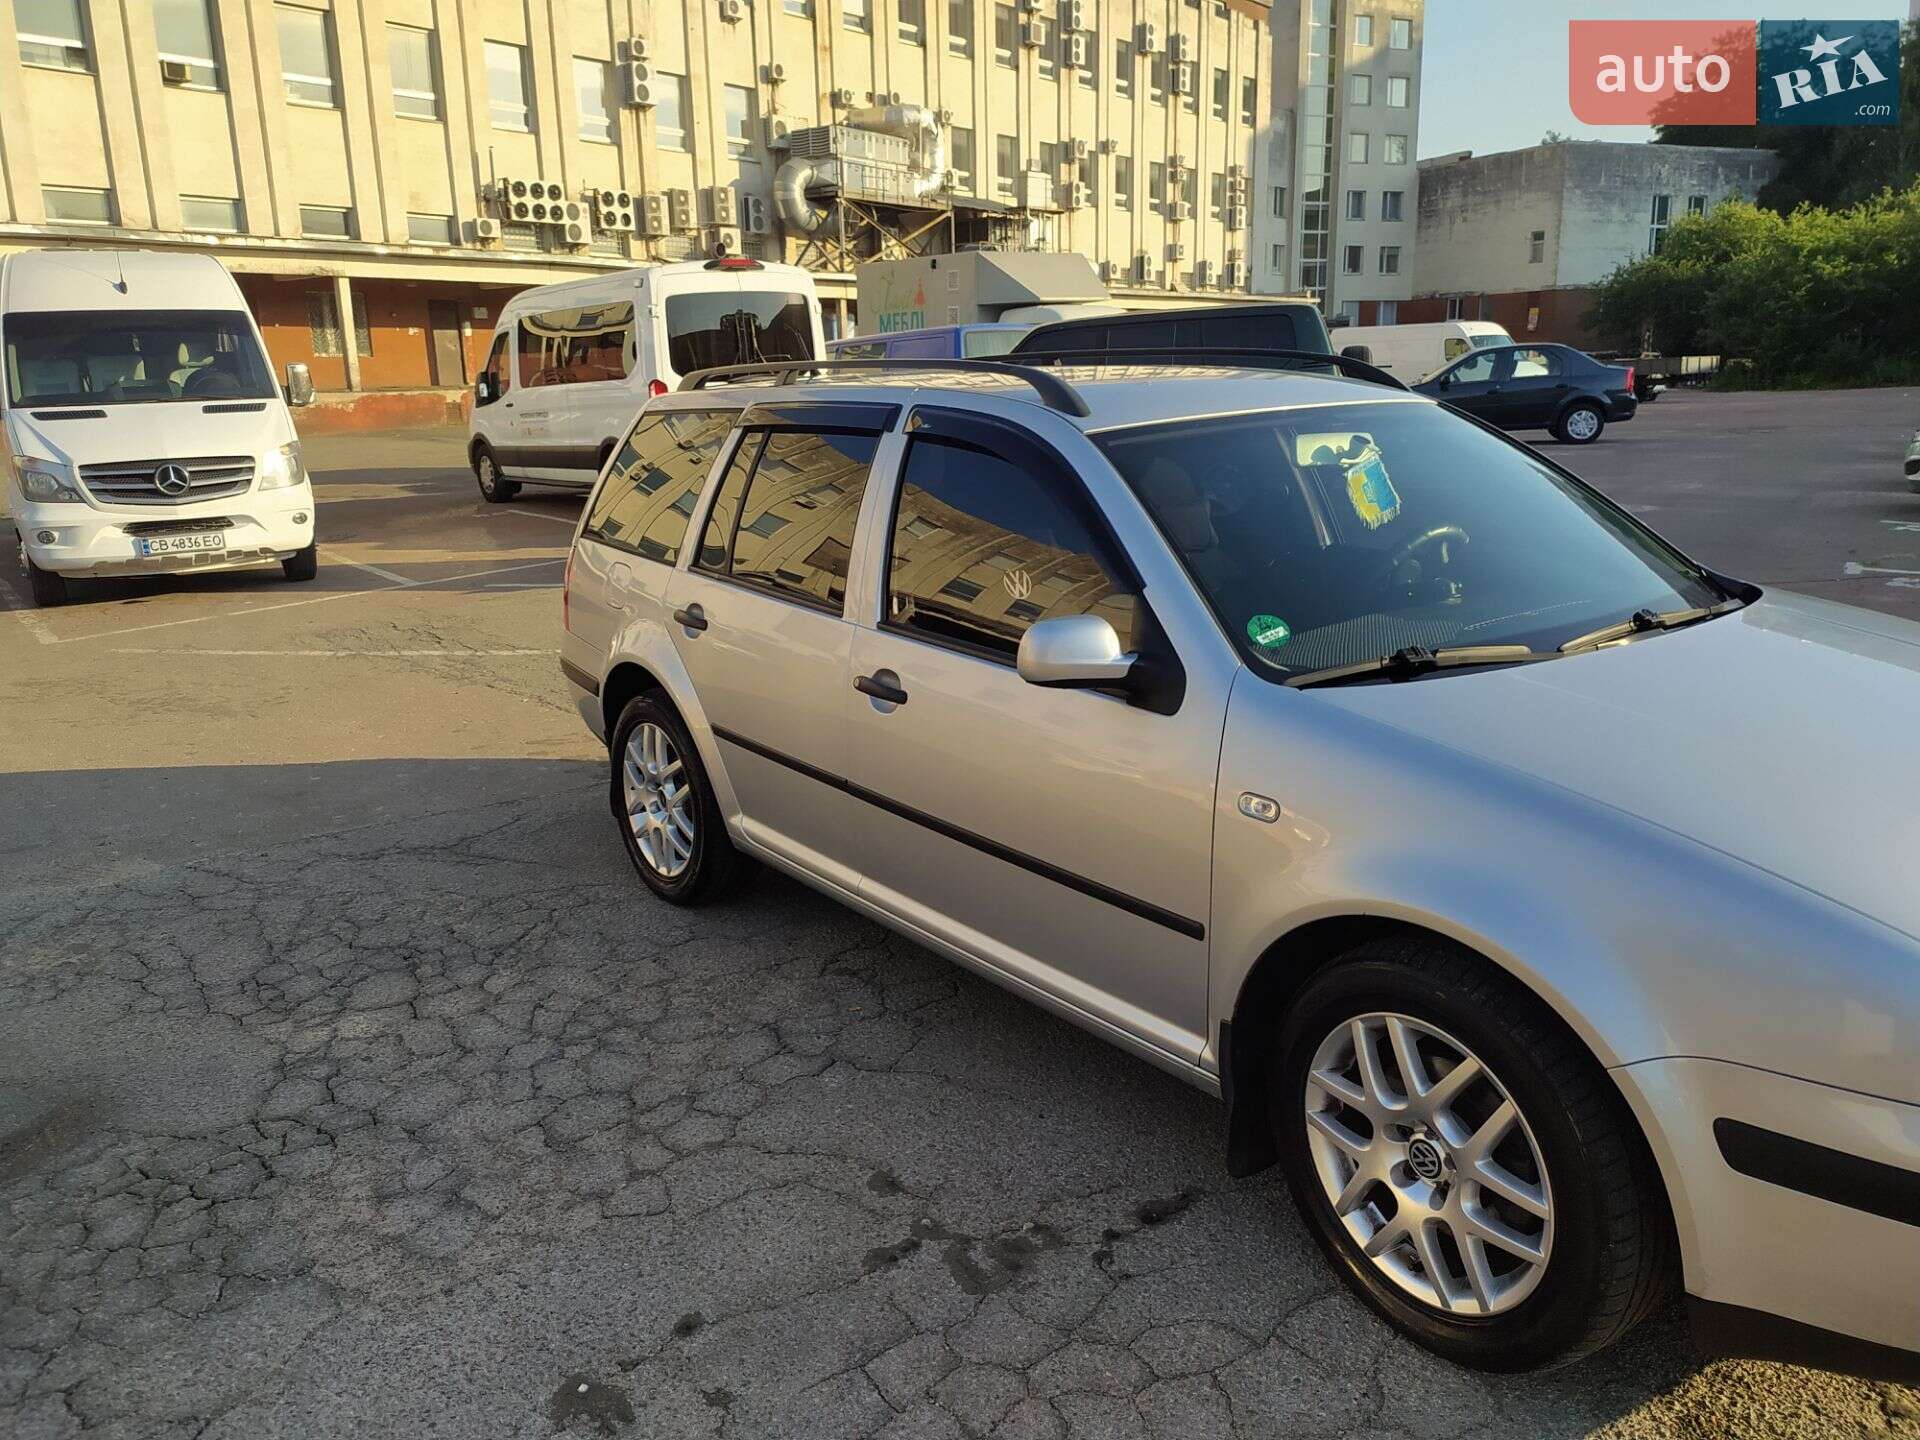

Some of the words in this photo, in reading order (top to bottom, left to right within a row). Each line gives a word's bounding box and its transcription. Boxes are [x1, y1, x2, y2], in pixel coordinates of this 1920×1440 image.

[150, 539, 169, 551] CB
[171, 537, 201, 550] 4836
[202, 535, 222, 547] EO
